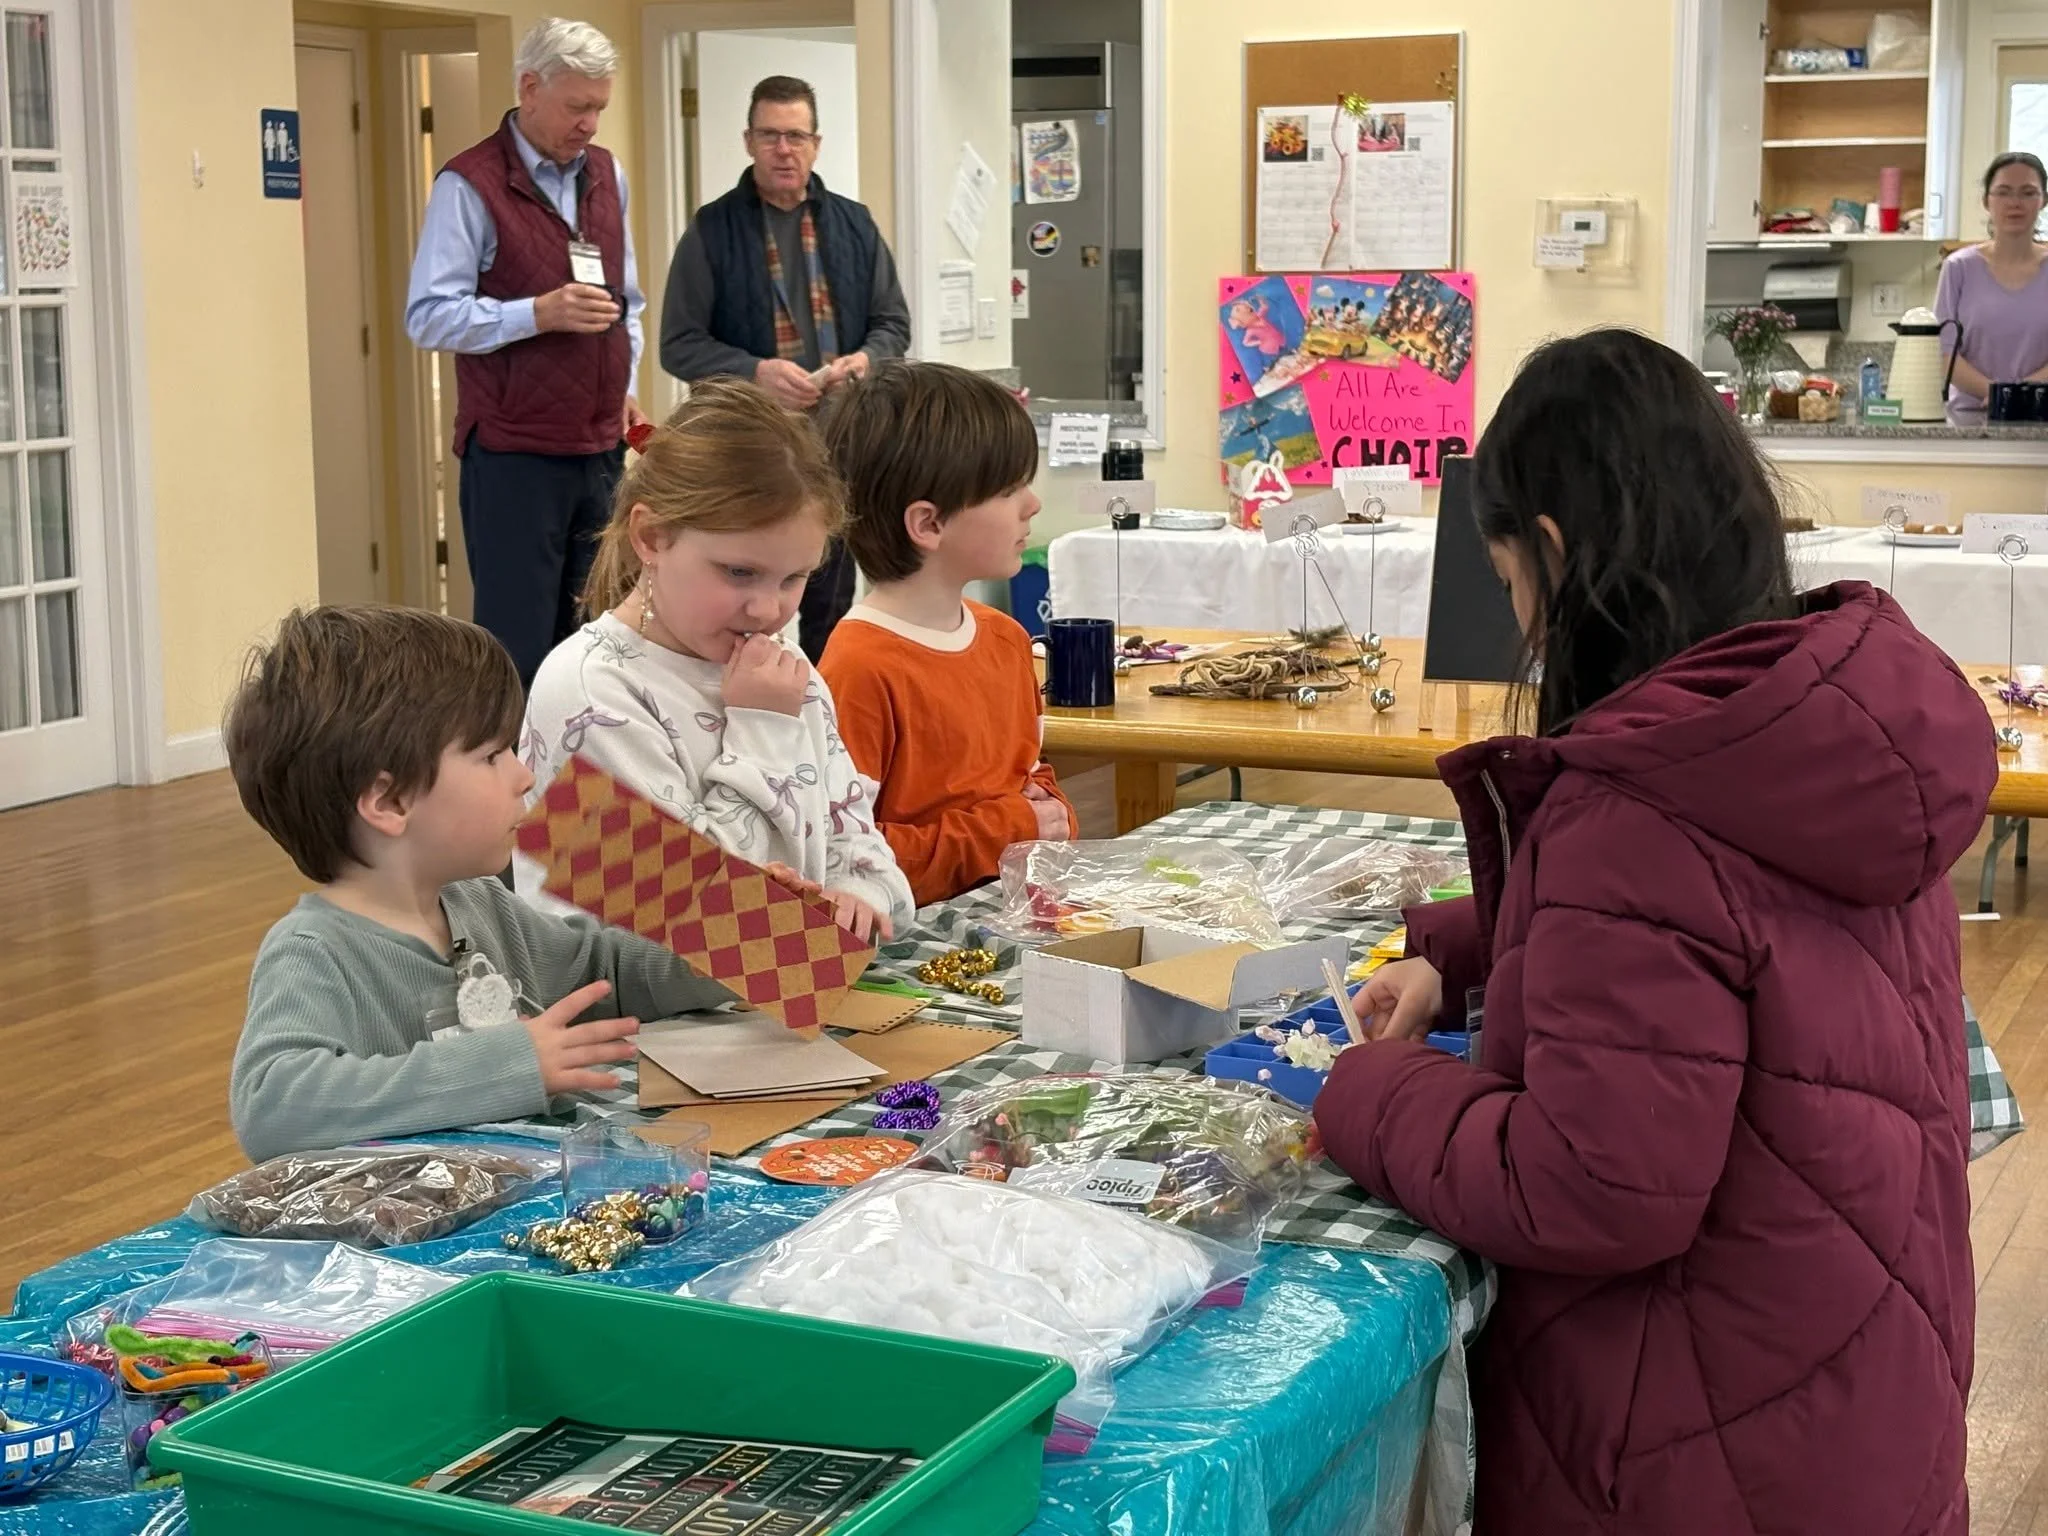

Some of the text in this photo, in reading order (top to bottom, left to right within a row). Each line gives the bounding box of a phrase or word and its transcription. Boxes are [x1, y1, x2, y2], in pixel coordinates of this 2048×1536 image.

[1336, 371, 1423, 399] All Are
[1329, 404, 1467, 433] Welcome In
[471, 1434, 608, 1499] LAUGH
[600, 1441, 719, 1502] HOME
[708, 1449, 769, 1476] LIFE
[740, 1453, 815, 1499] FAMILY
[778, 1457, 870, 1510] LOVE
